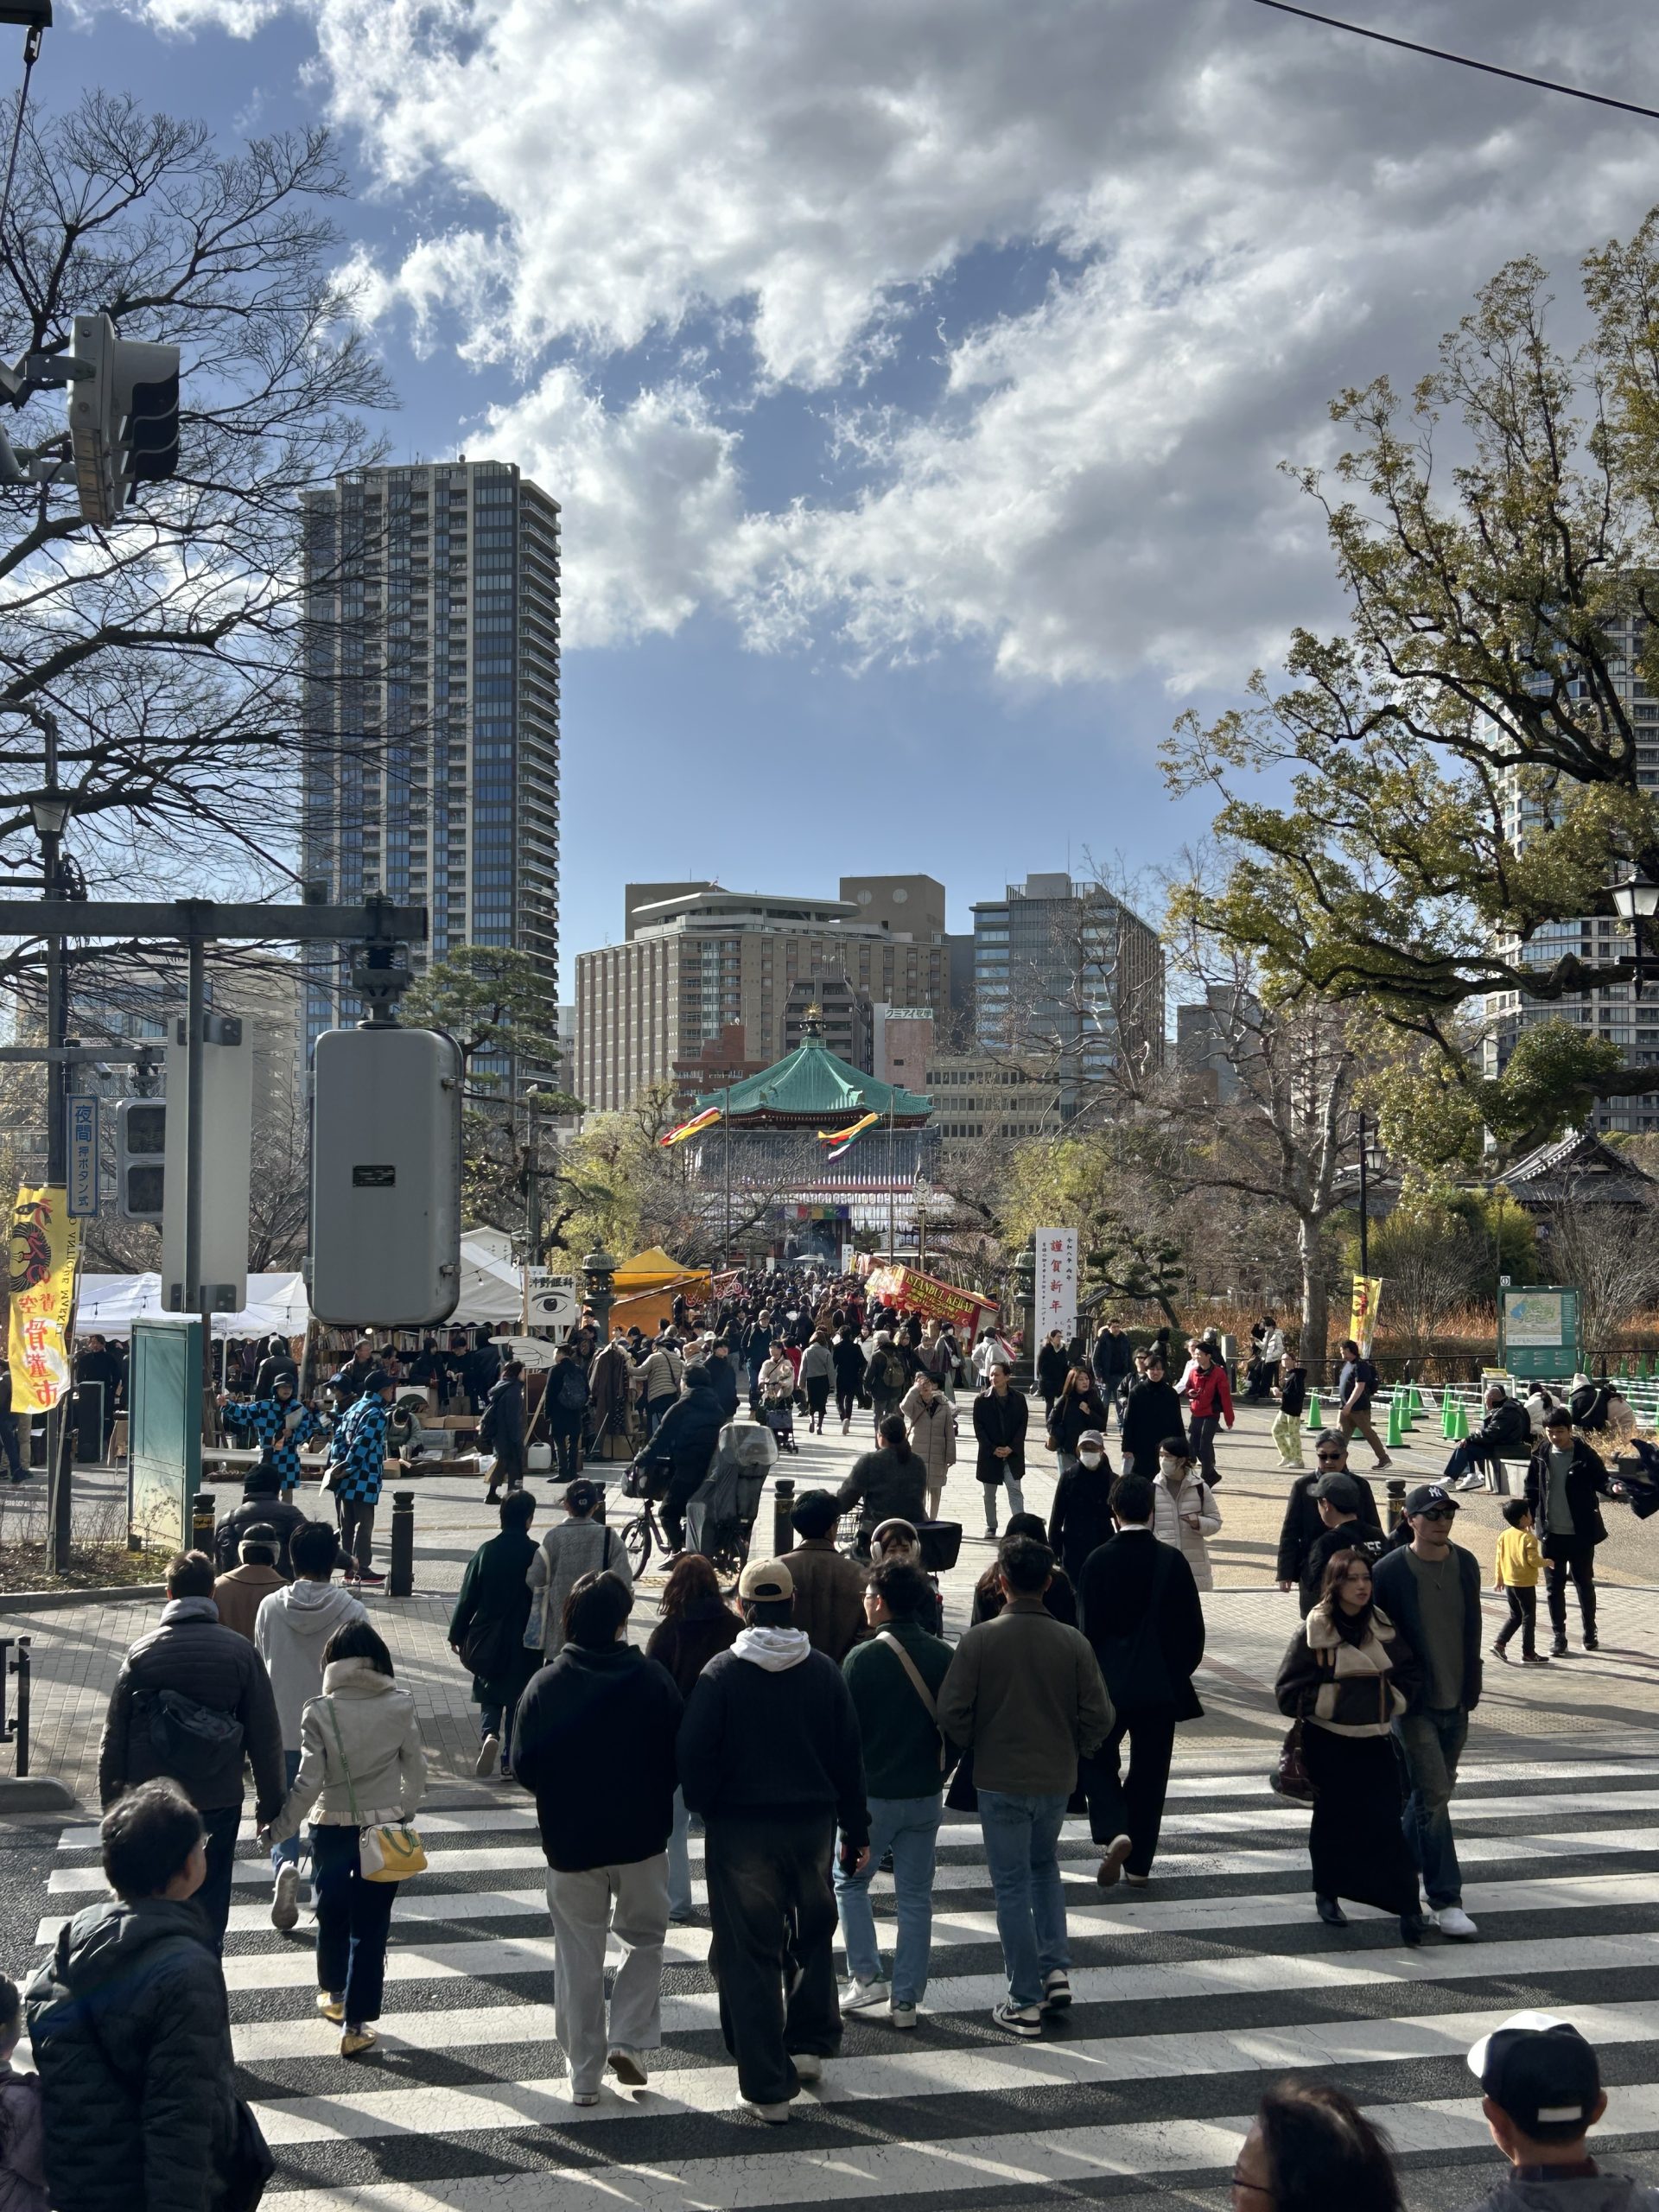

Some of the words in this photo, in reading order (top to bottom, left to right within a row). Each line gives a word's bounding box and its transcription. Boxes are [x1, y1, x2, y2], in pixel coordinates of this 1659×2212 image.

[906, 1274, 944, 1300] ISTANBUL
[945, 1293, 975, 1313] KEBAB
[1050, 1239, 1063, 1313] 謹賀新年
[1428, 1486, 1442, 1497] NY
